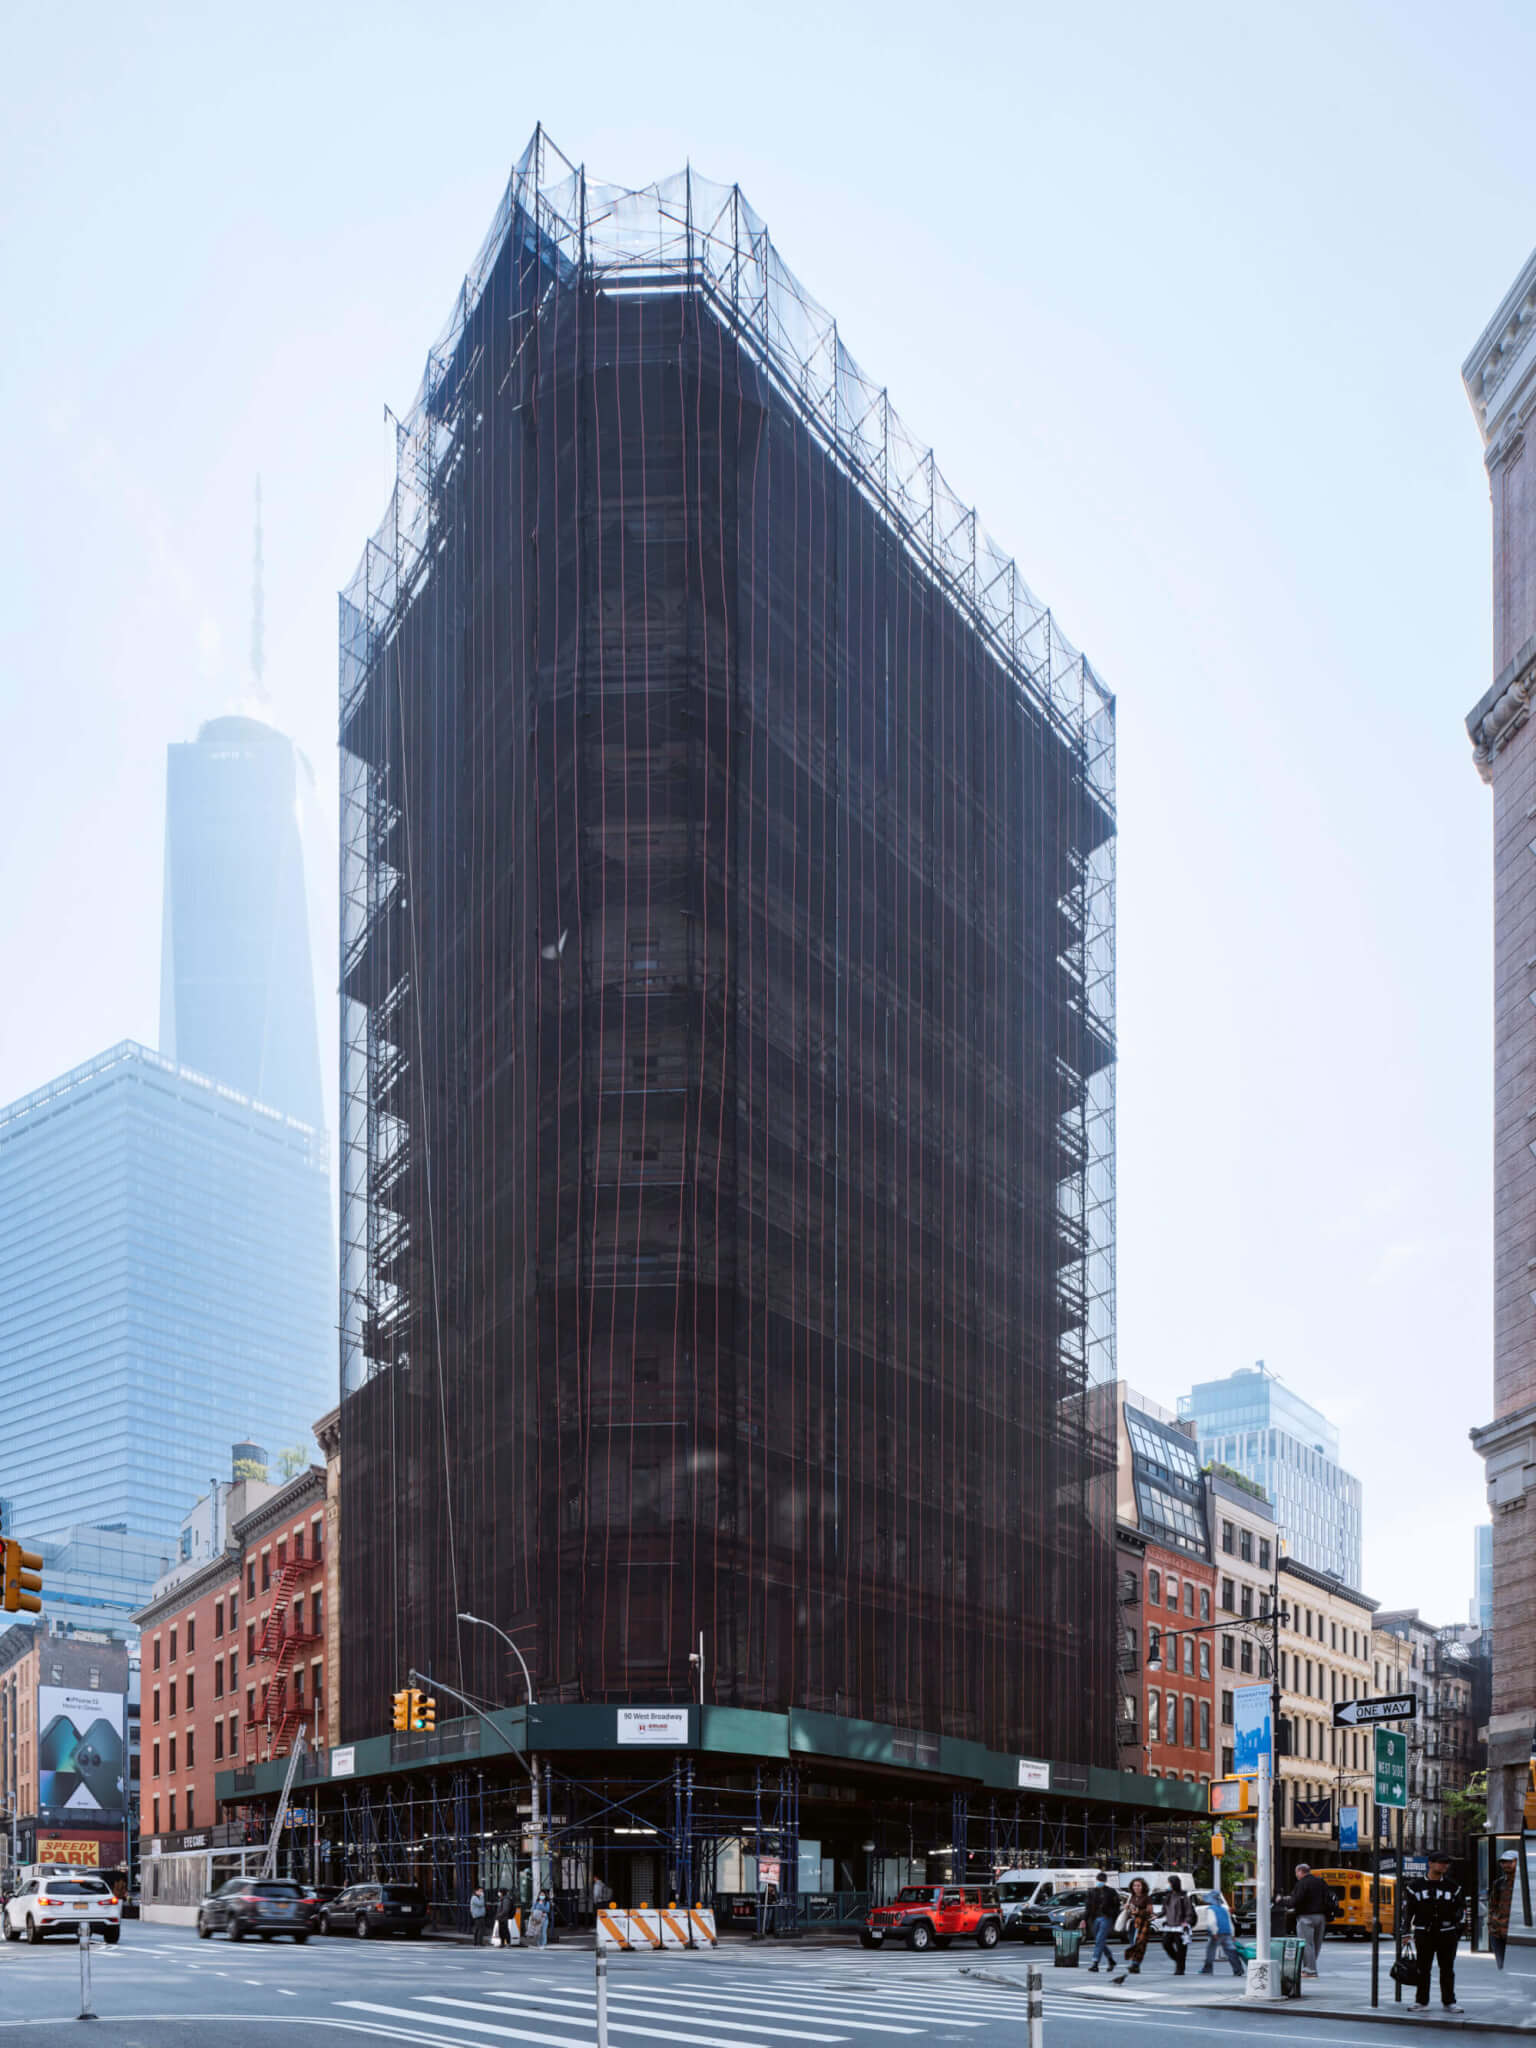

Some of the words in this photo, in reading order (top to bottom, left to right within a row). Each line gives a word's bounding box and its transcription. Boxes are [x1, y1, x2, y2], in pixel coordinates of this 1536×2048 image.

[651, 1713, 683, 1721] Broadway
[1356, 1705, 1379, 1718] ONE
[1383, 1702, 1407, 1714] WAY
[1392, 1764, 1404, 1778] SIDE
[45, 1841, 97, 1851] SPEEDY
[40, 1851, 97, 1866] PARK
